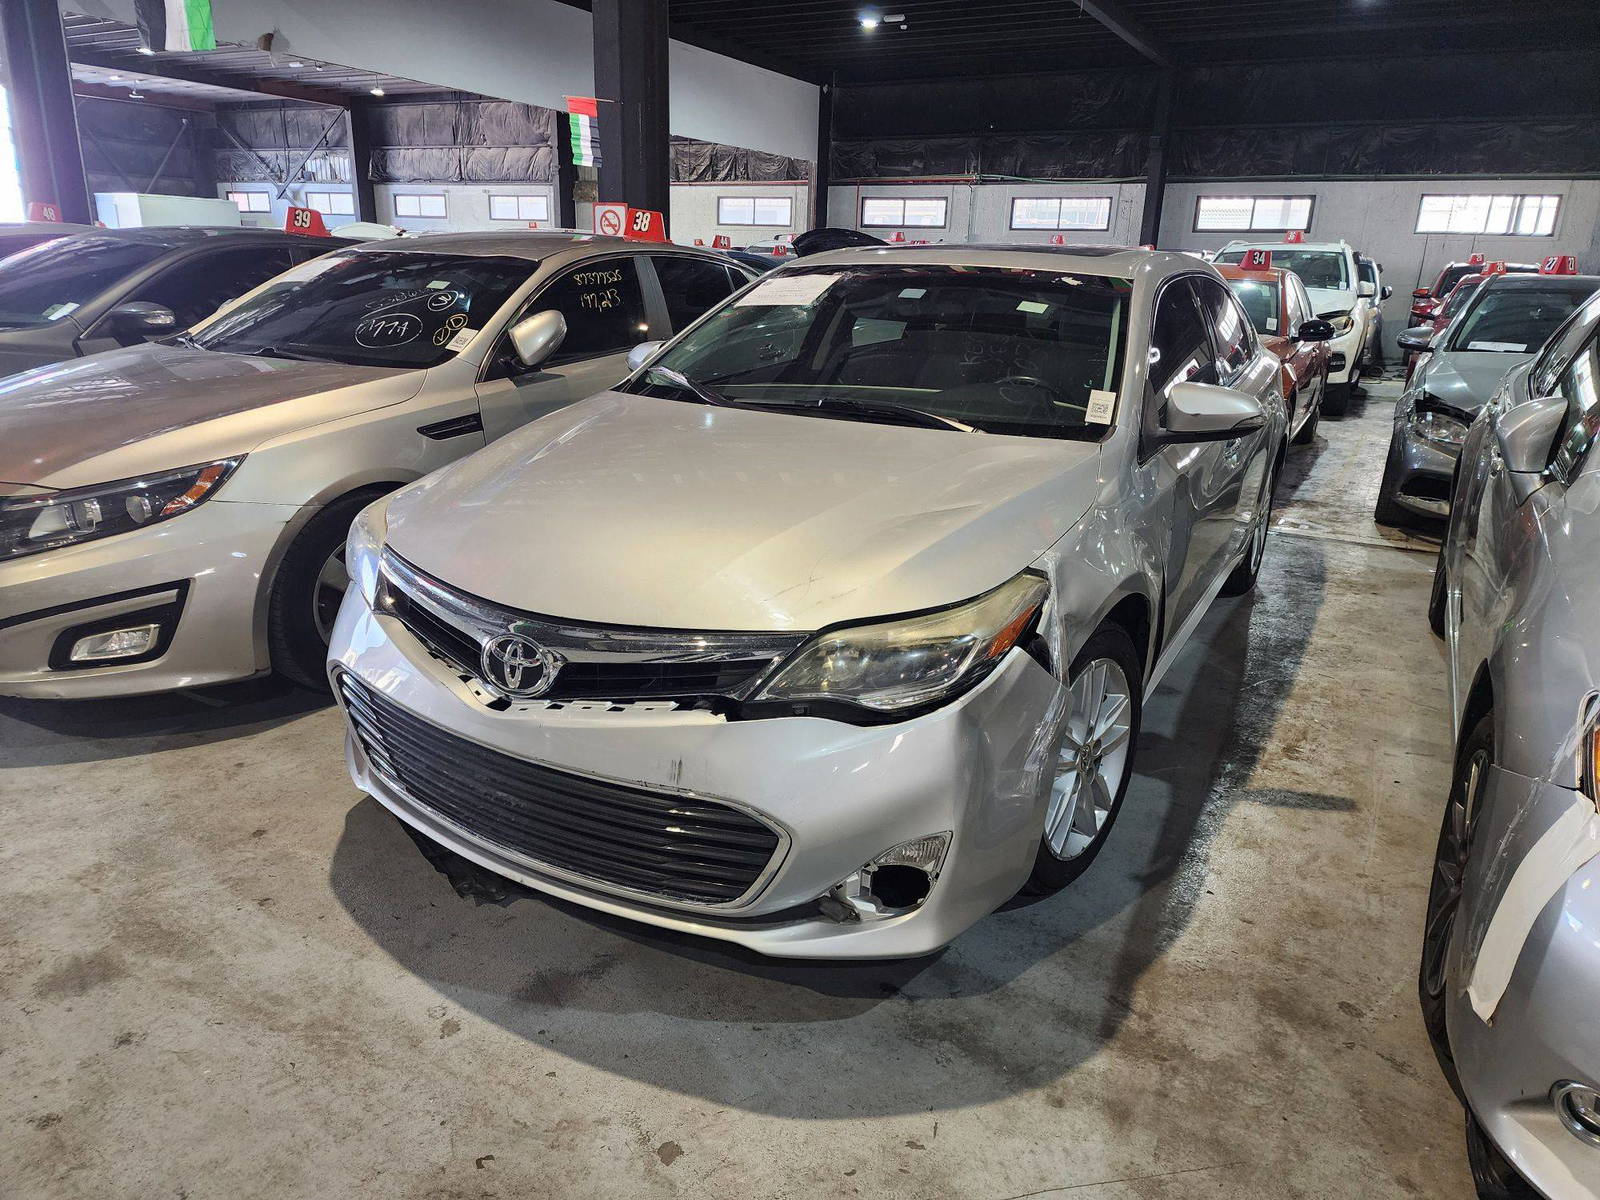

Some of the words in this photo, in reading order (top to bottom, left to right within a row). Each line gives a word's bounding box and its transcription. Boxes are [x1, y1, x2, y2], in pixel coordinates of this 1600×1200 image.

[294, 209, 311, 228] 39
[632, 211, 651, 232] 38
[1253, 251, 1266, 265] 34
[1544, 256, 1559, 271] 27
